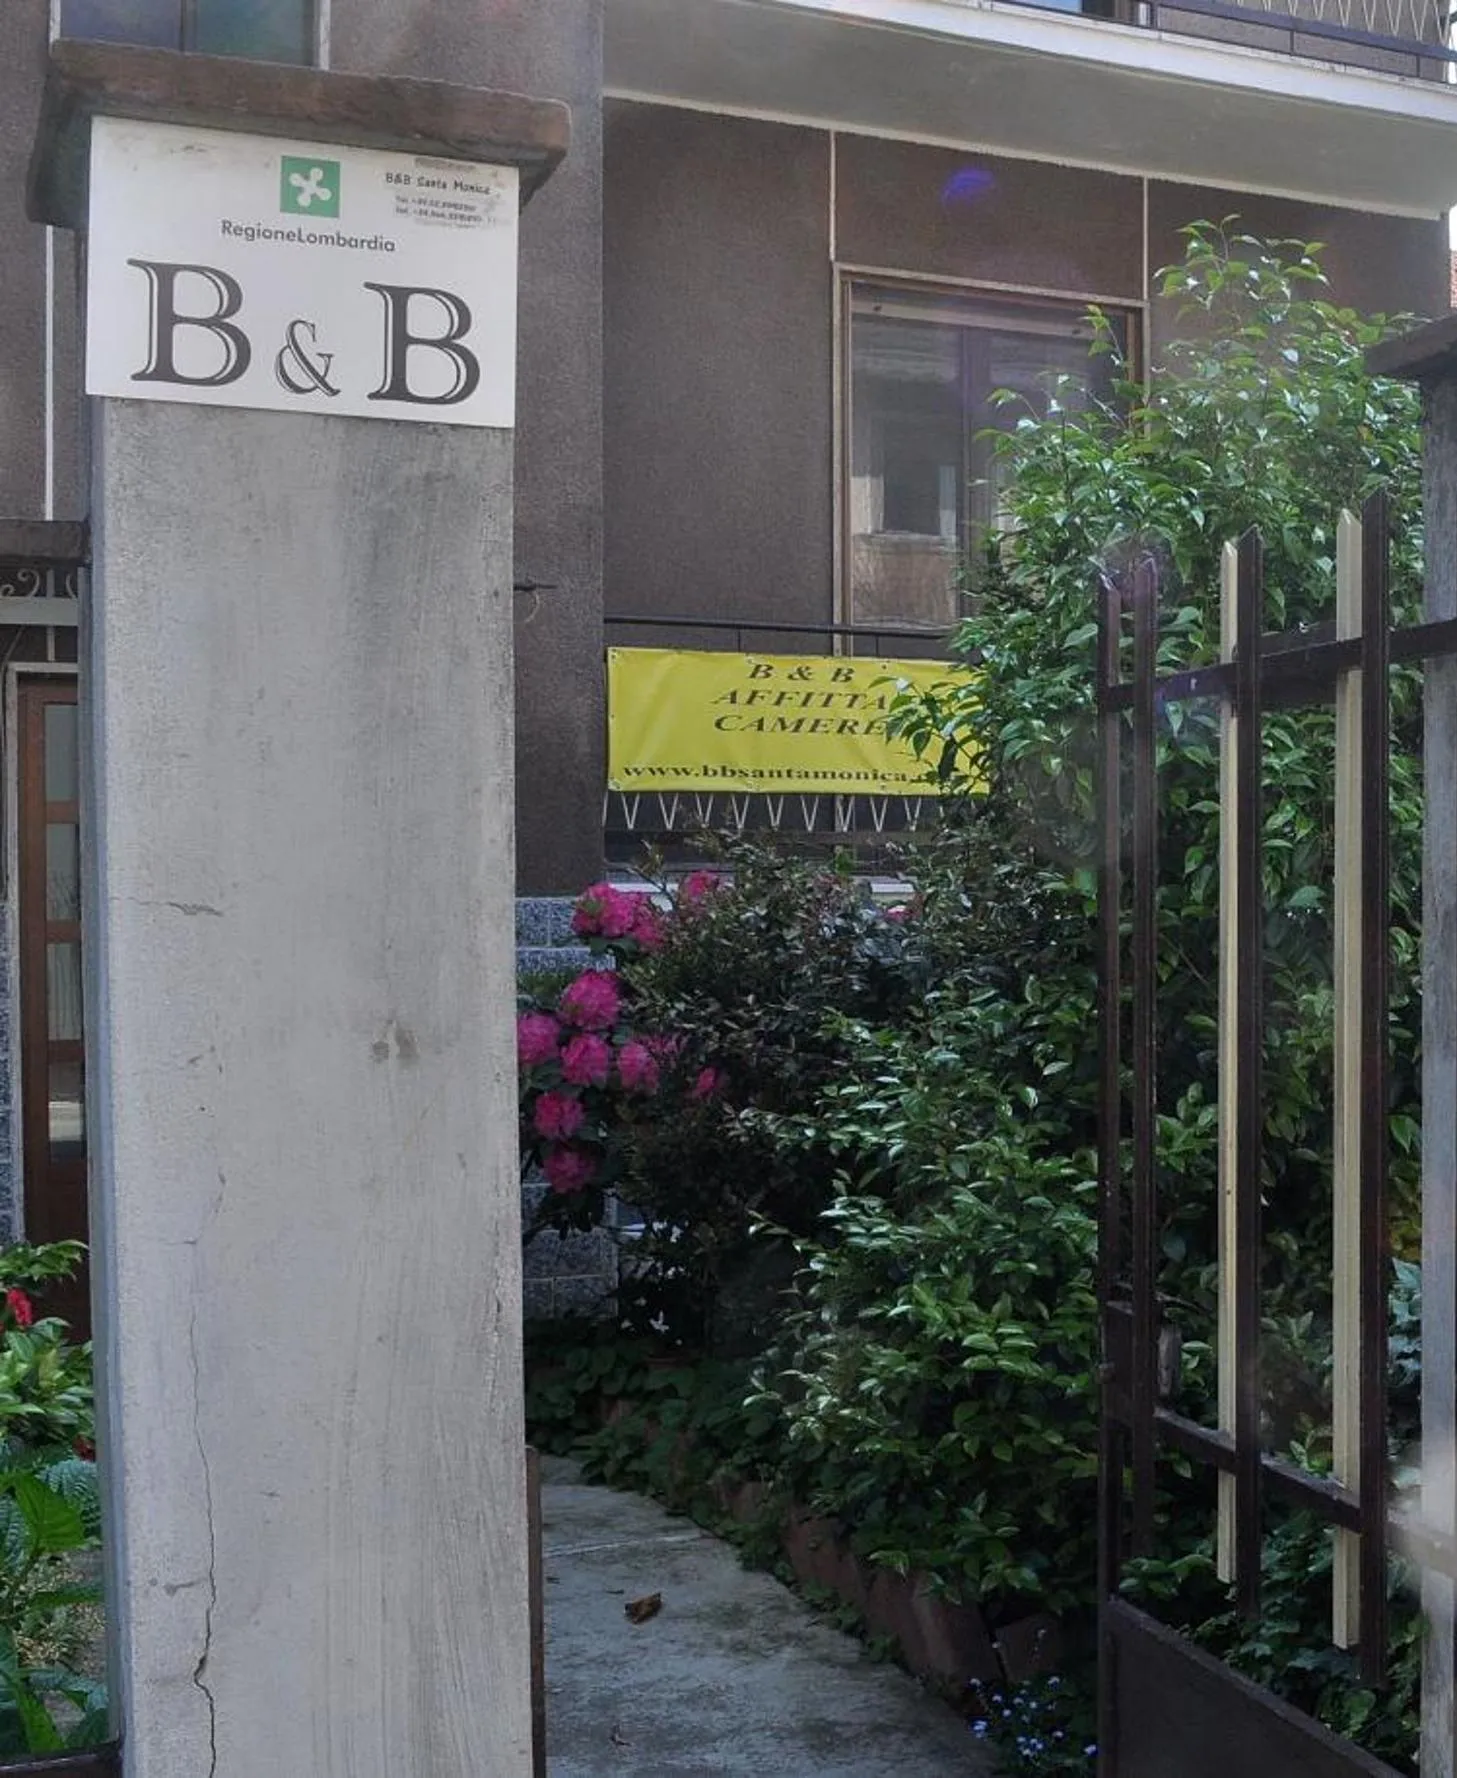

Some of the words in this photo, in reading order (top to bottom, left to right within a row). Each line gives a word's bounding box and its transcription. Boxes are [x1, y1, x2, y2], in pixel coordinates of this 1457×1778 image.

[127, 258, 251, 386] B
[275, 319, 341, 397] &
[364, 281, 480, 405] B
[748, 664, 774, 680] B
[788, 666, 812, 681] &
[831, 667, 855, 683] B
[712, 688, 887, 711] AFFITTA
[714, 714, 889, 735] CAMERE
